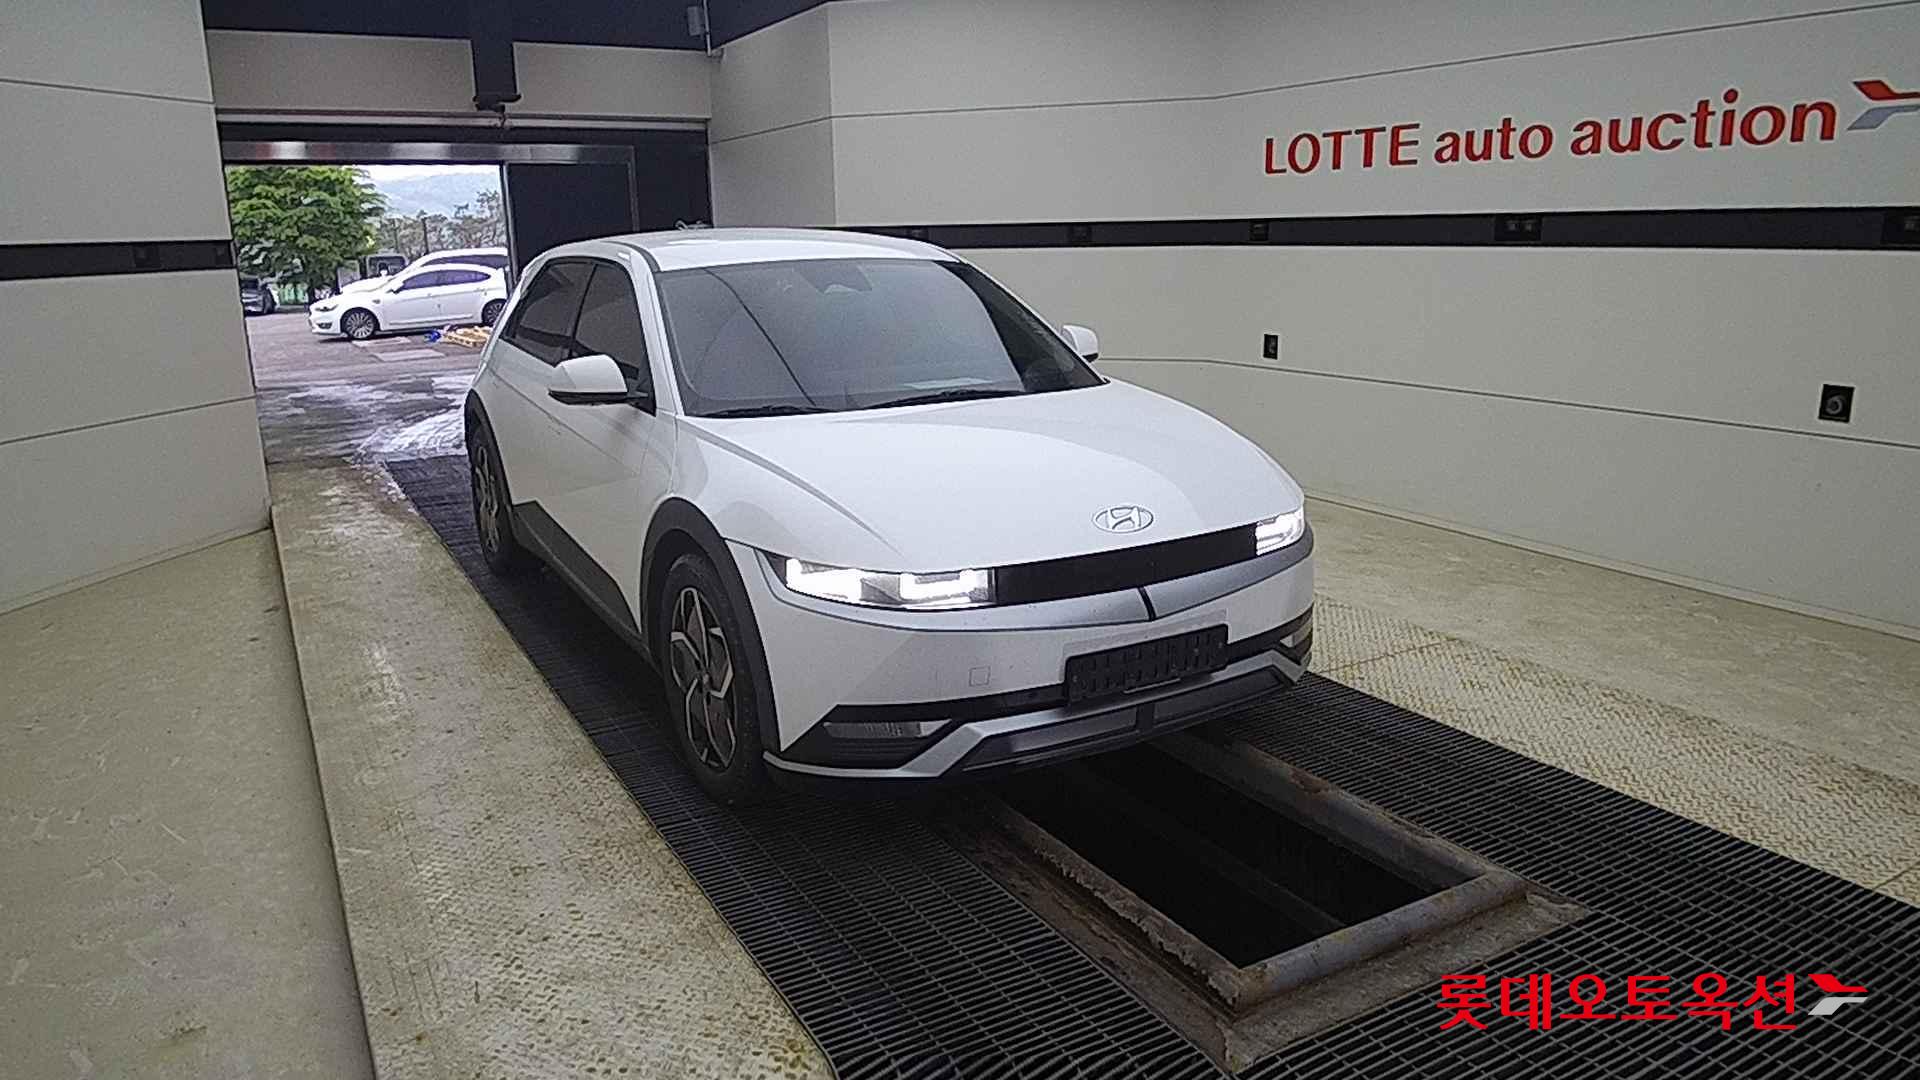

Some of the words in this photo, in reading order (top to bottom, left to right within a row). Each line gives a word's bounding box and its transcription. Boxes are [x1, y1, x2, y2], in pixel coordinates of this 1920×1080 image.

[1264, 122, 1421, 175] LOTTE
[1434, 117, 1553, 164] auto
[1570, 87, 1837, 156] auction
